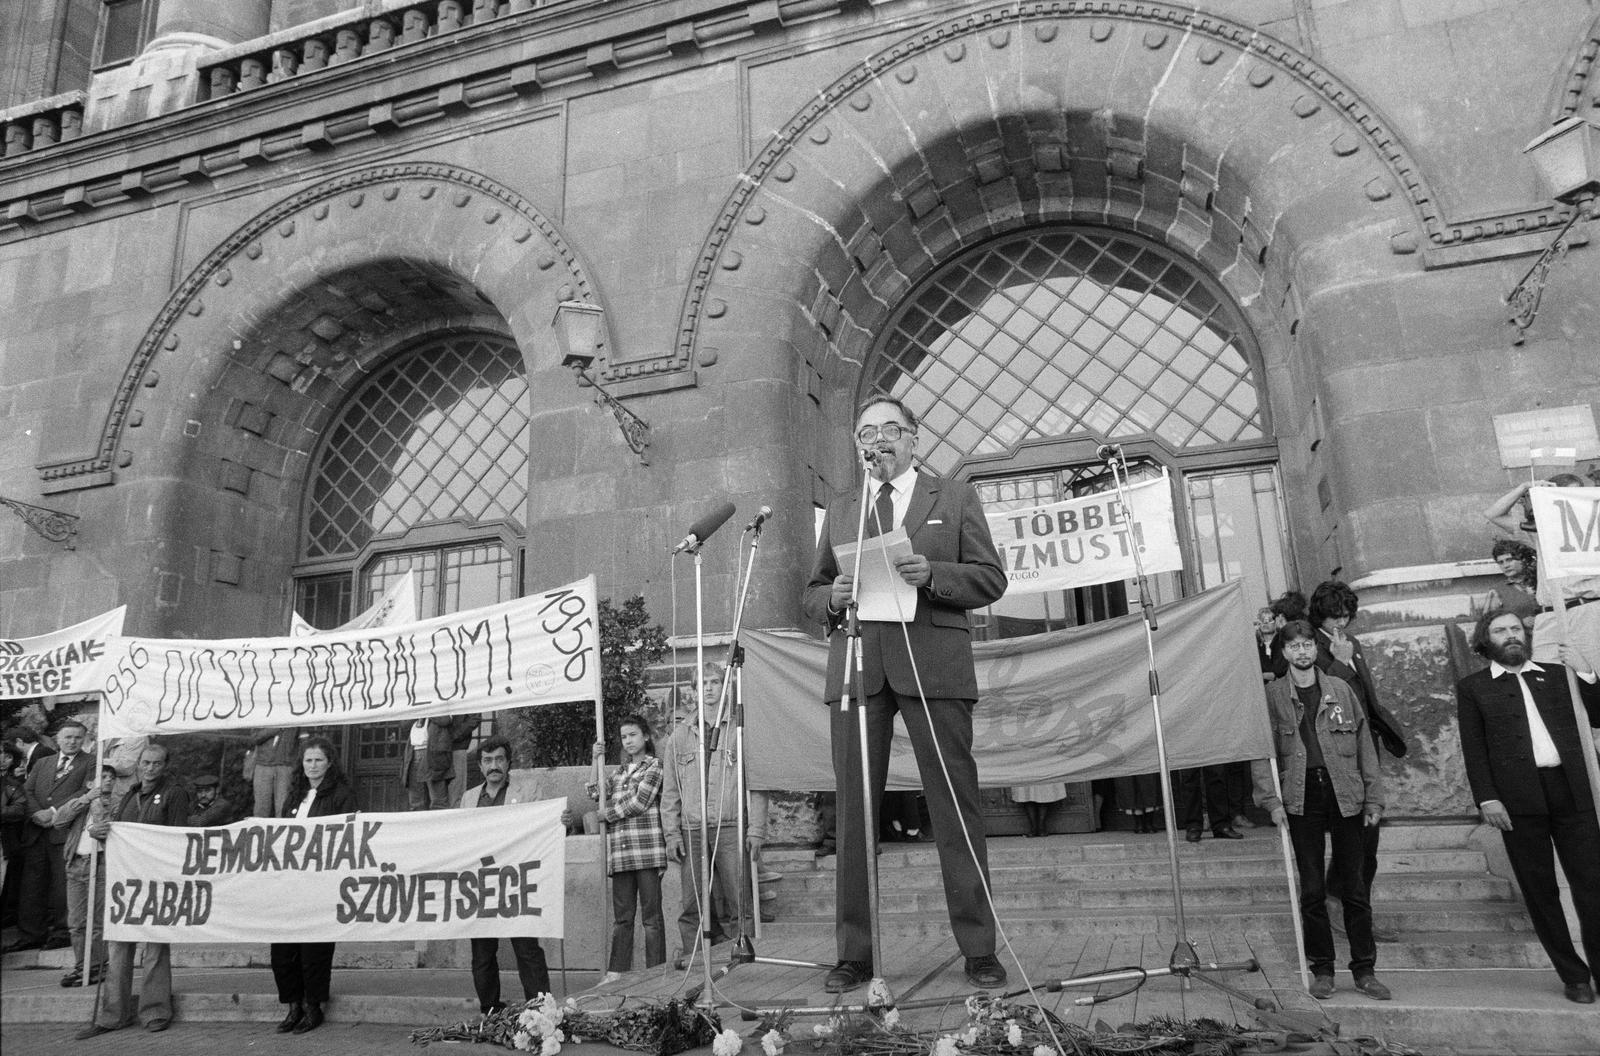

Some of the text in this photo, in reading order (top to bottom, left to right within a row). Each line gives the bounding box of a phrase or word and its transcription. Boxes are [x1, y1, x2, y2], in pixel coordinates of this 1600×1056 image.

[998, 522, 1146, 572] IZMUST!
[266, 614, 513, 717] FORRADALOM!
[537, 588, 593, 682] 1956
[0, 667, 72, 696] TSEGE
[102, 640, 149, 716] 1956
[181, 814, 383, 876] DEMOKRATÁK
[109, 855, 542, 926] SZABAD SZÖVETSÉGE
